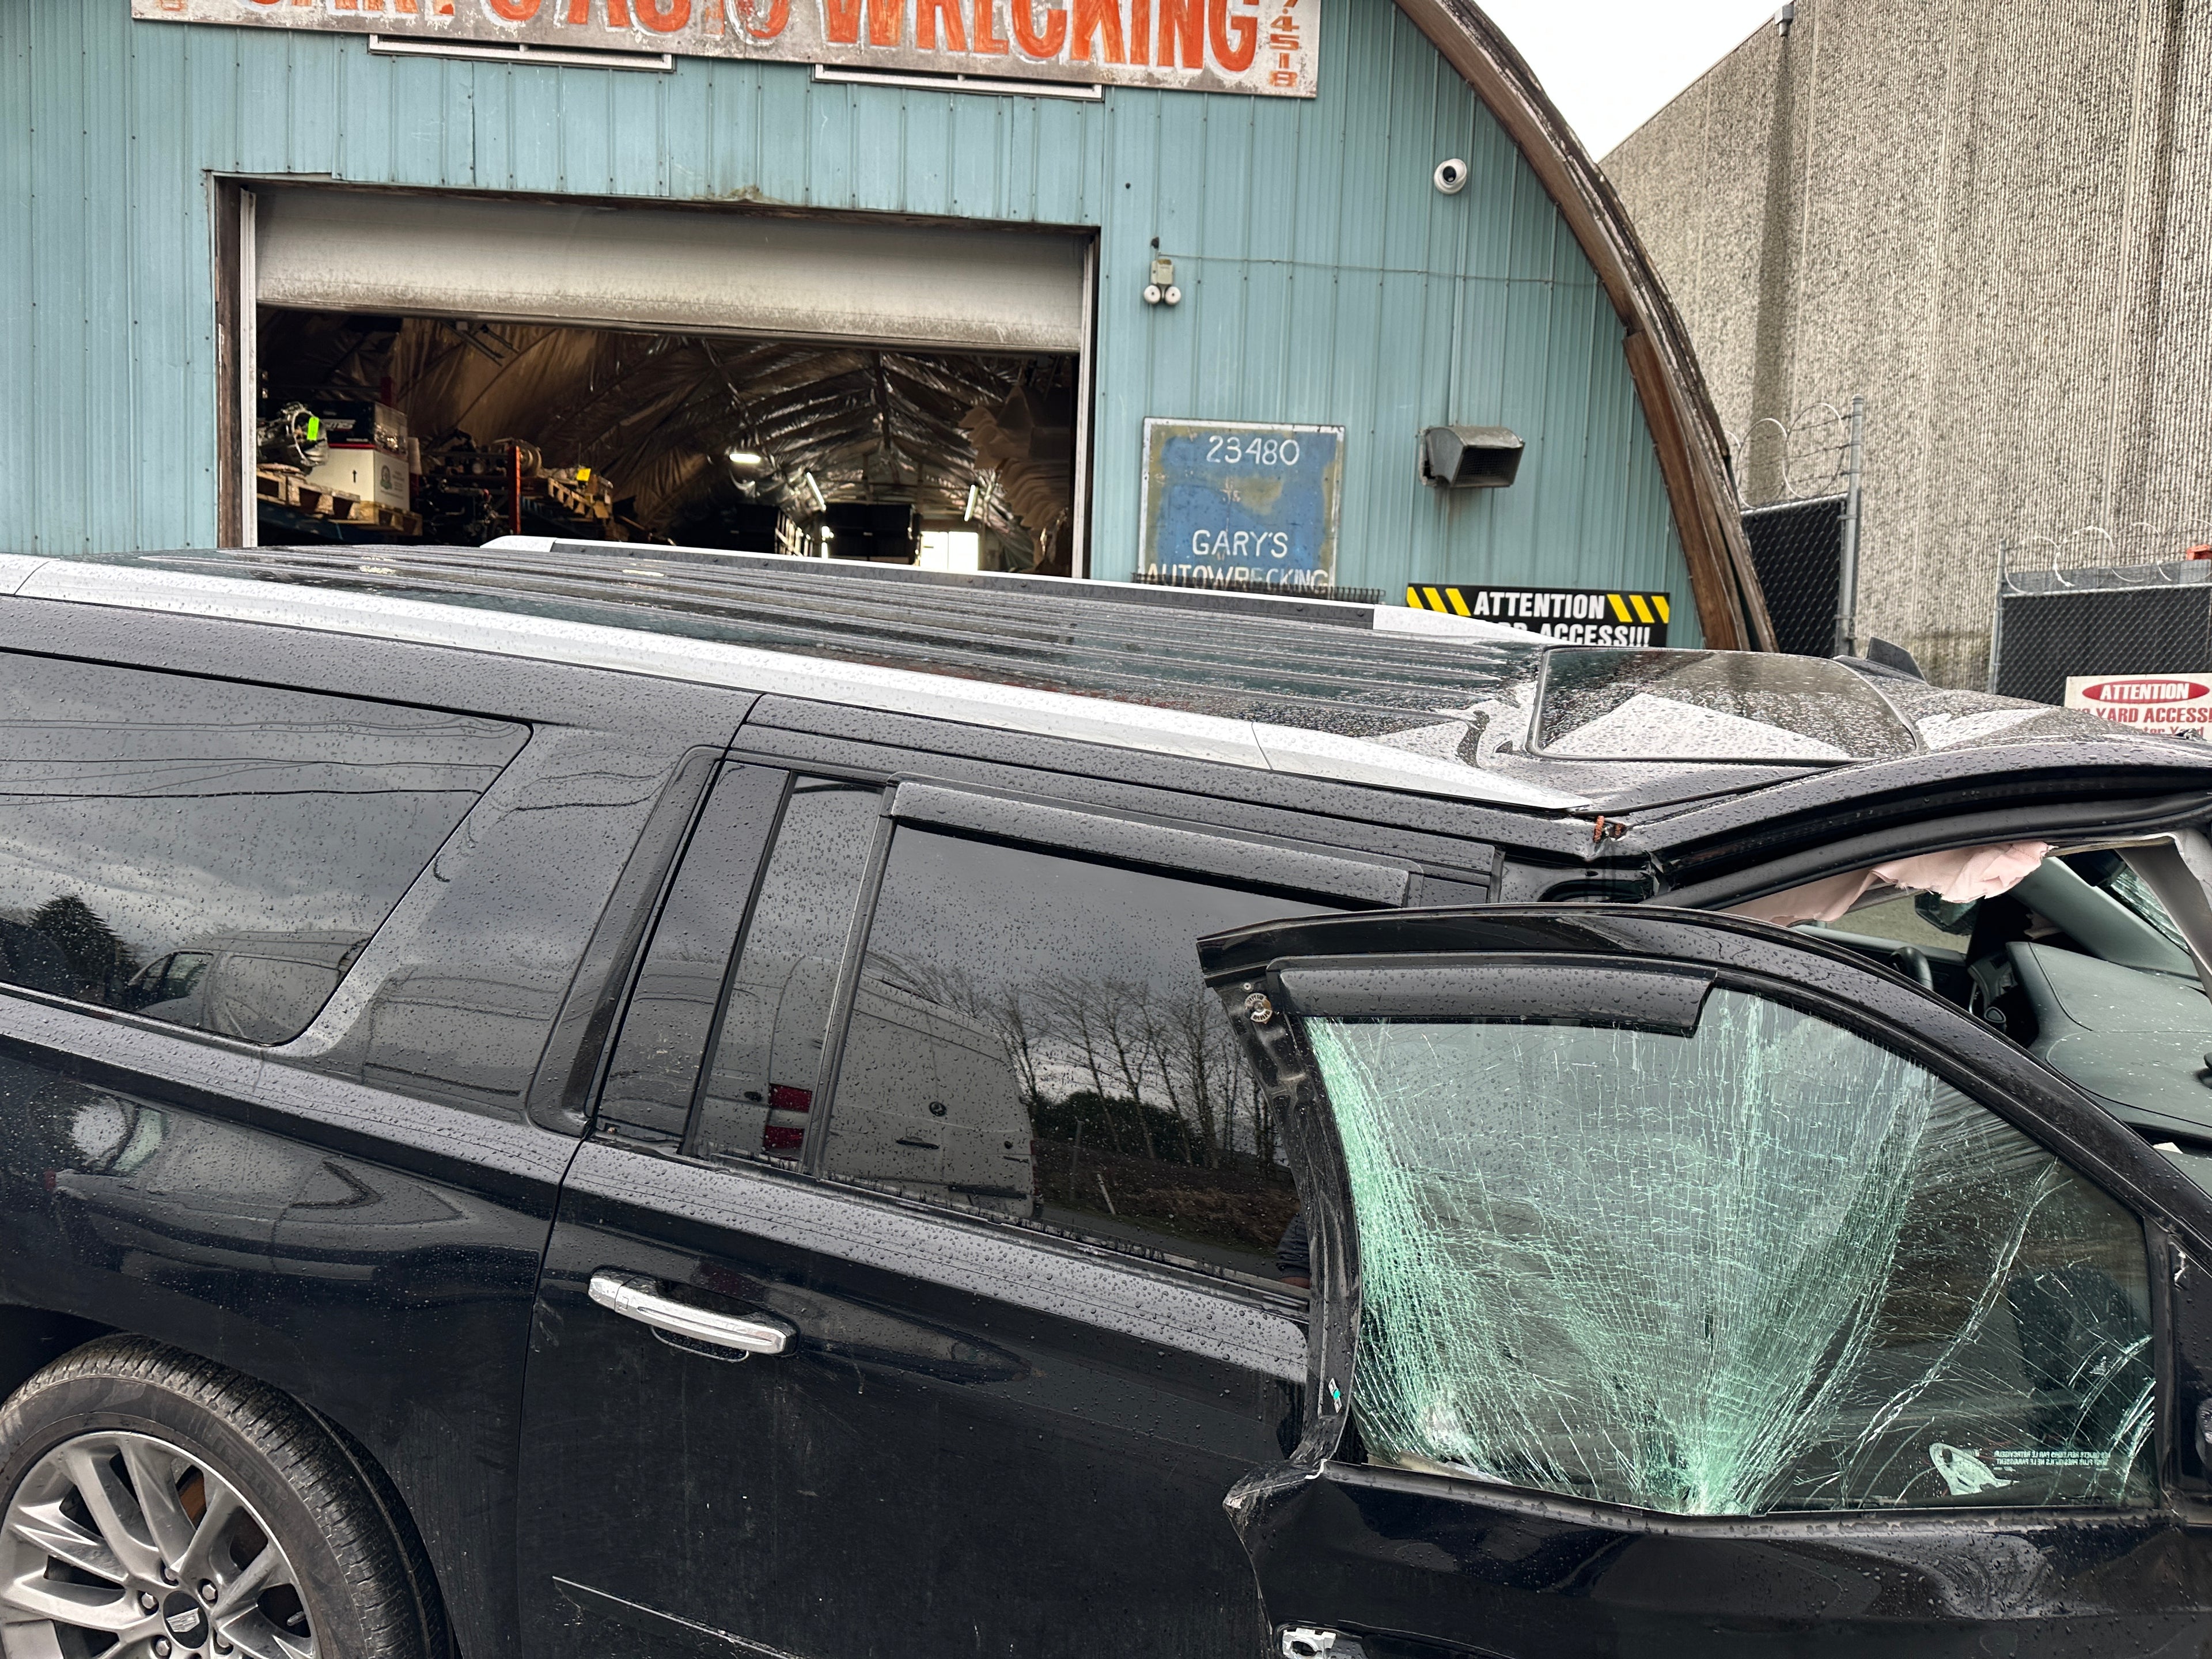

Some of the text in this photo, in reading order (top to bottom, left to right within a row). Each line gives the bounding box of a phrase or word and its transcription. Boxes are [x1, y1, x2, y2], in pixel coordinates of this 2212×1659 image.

[1206, 435, 1300, 465] 23480
[1192, 529, 1289, 558] GARY'S
[1474, 591, 1605, 620] ATTENTION
[2099, 683, 2190, 700] ATTENTION
